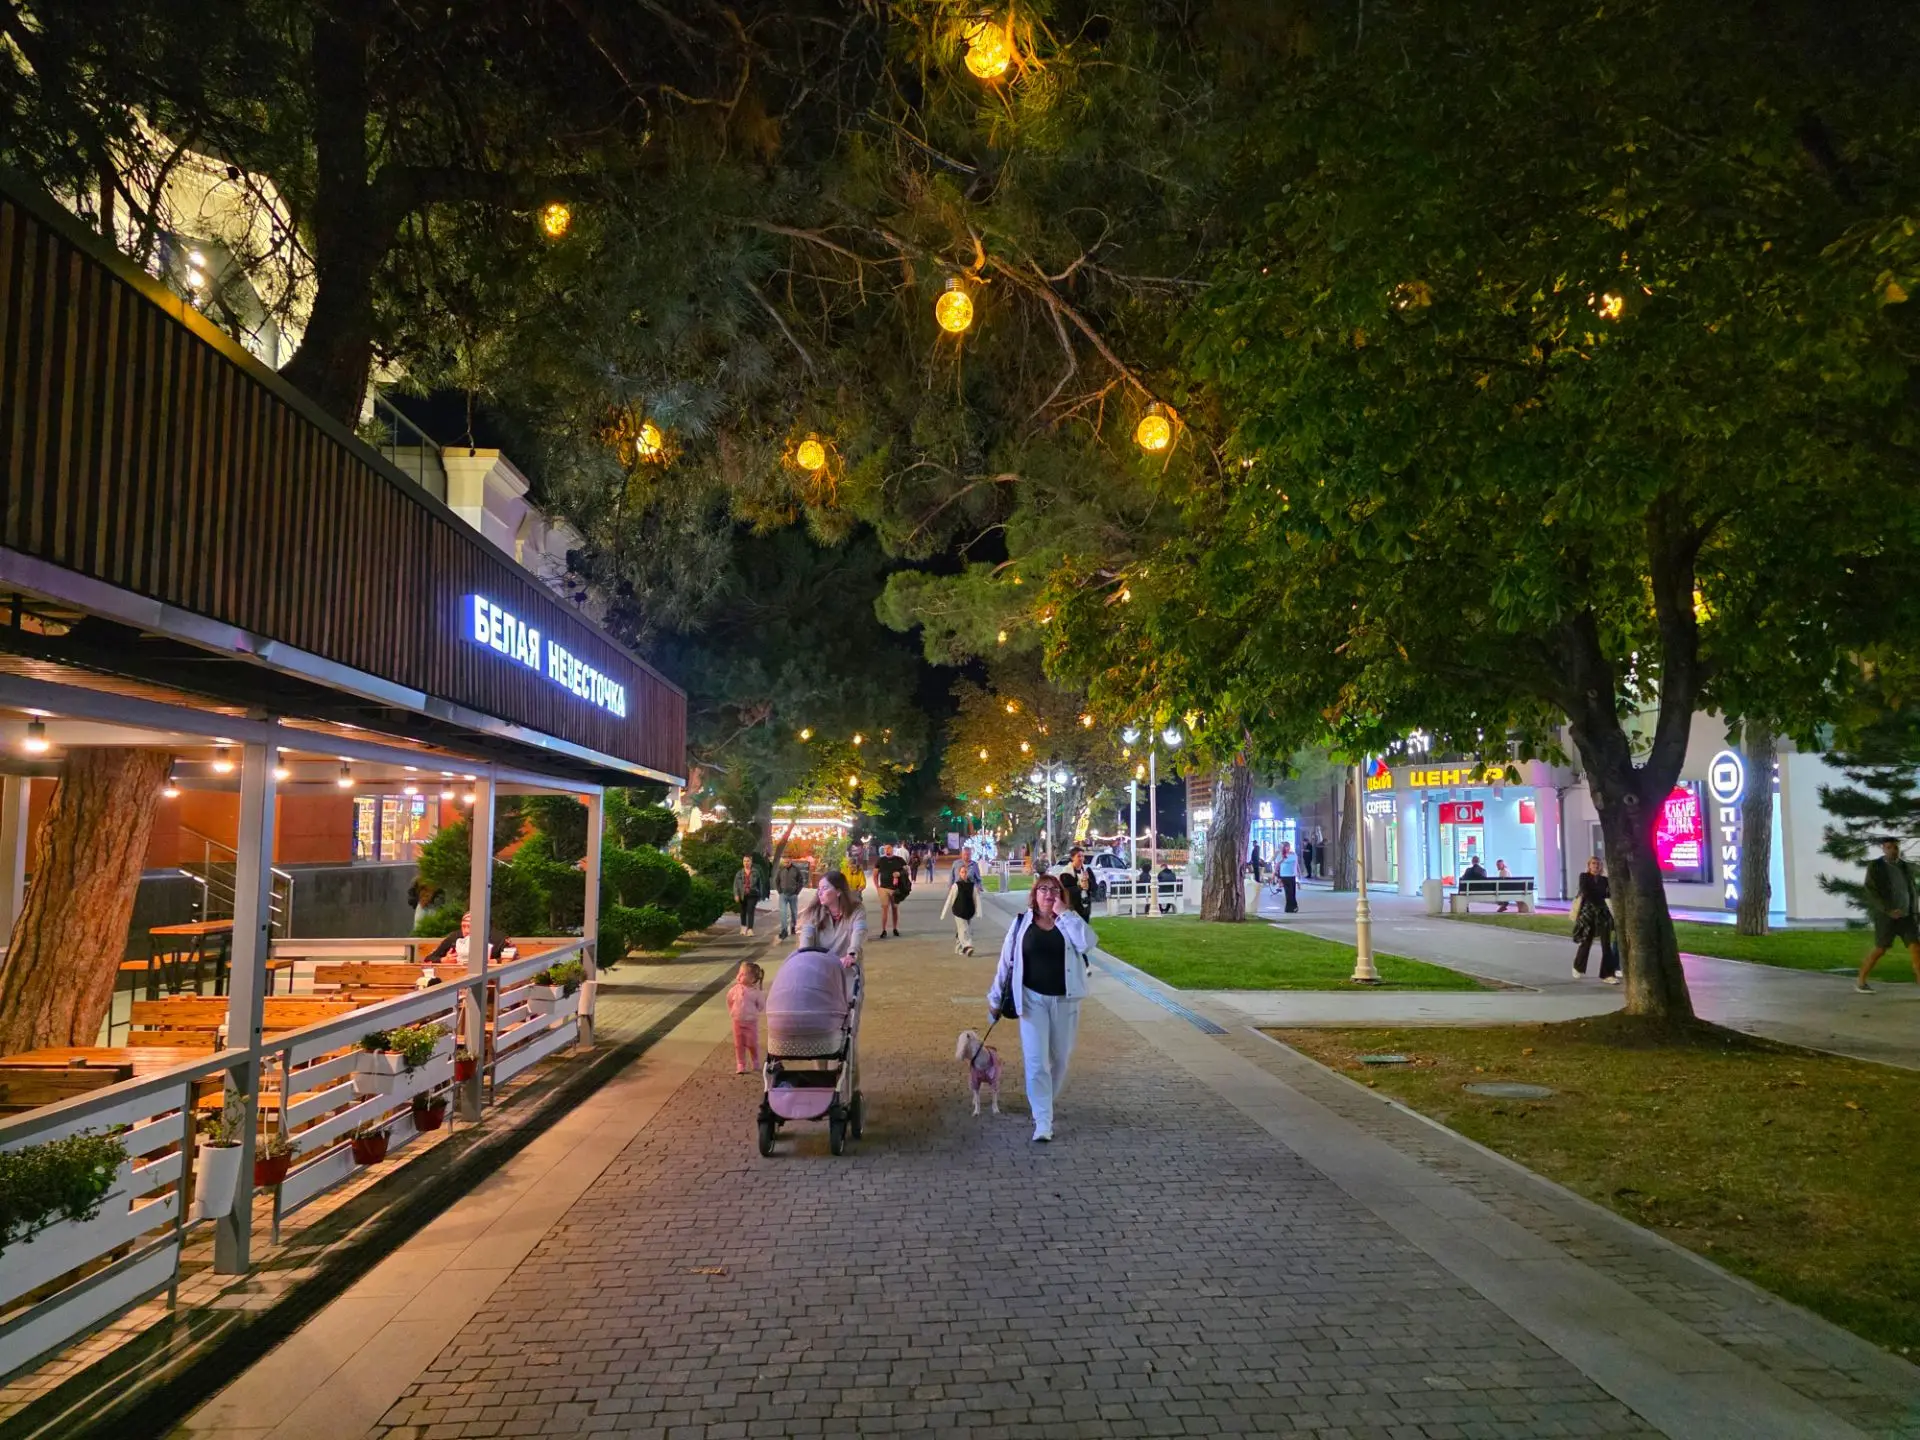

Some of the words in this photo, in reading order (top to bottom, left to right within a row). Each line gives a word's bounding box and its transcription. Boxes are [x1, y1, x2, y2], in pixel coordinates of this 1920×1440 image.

[473, 594, 541, 671] БЕЛАЯ
[547, 639, 626, 718] НЕВЕСТОЧКА
[1367, 800, 1392, 814] COFFEE
